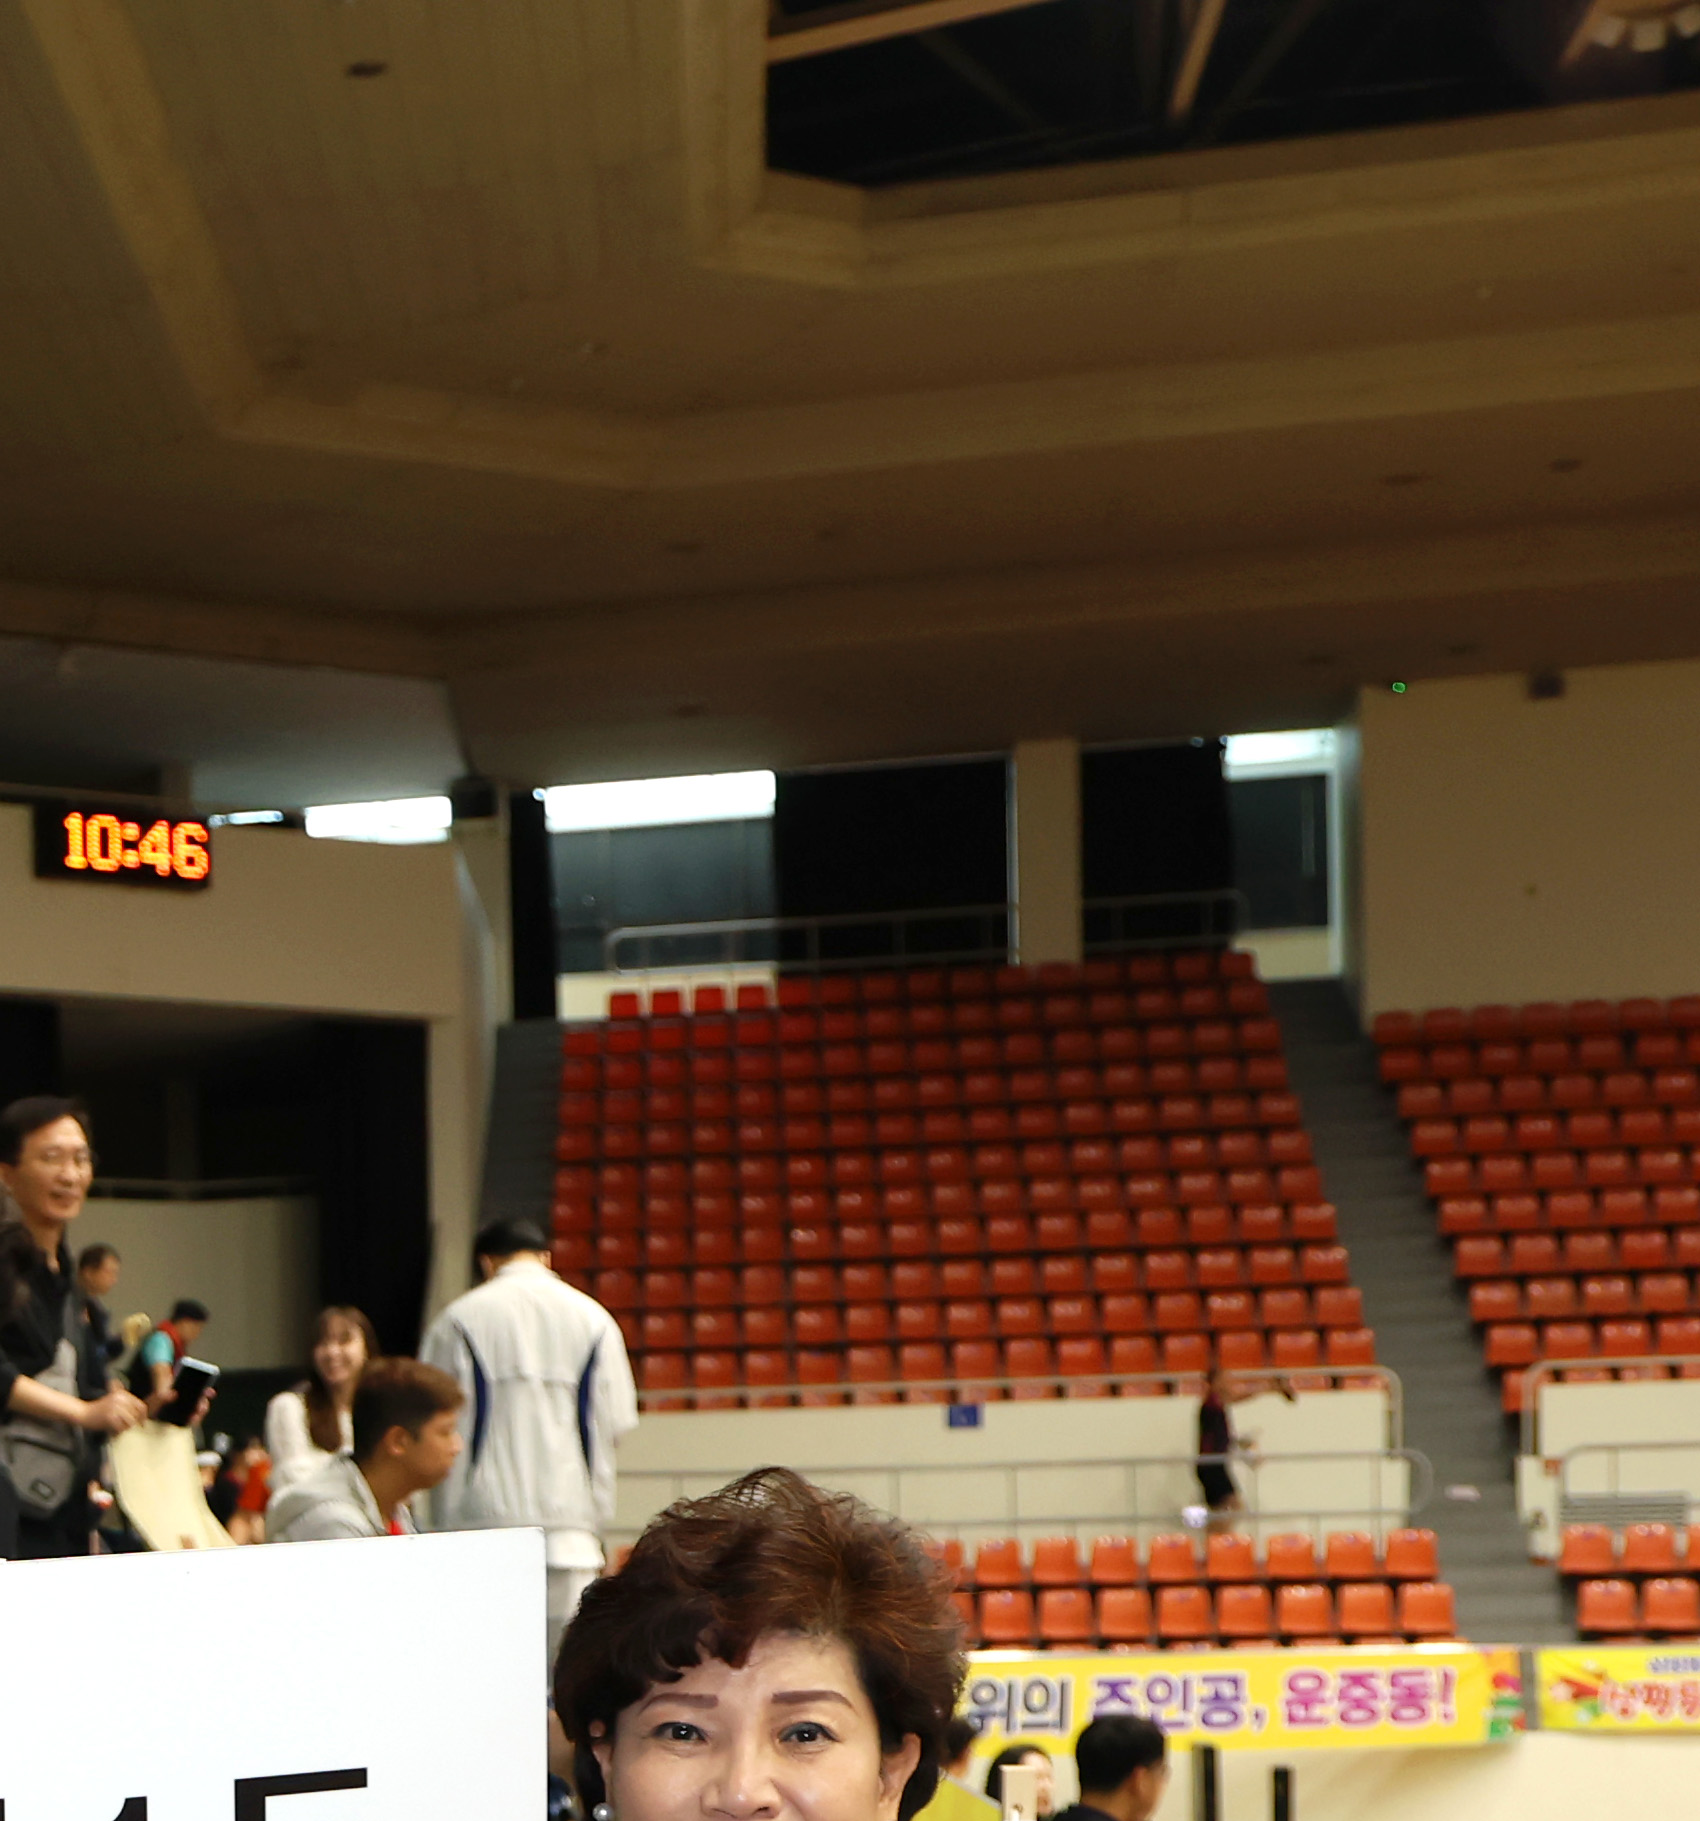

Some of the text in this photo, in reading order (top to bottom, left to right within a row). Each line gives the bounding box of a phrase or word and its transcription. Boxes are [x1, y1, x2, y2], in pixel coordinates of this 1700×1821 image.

[63, 811, 211, 880] 10:46
[967, 1677, 1070, 1734] 위의
[1284, 1668, 1456, 1729] 운중동!
